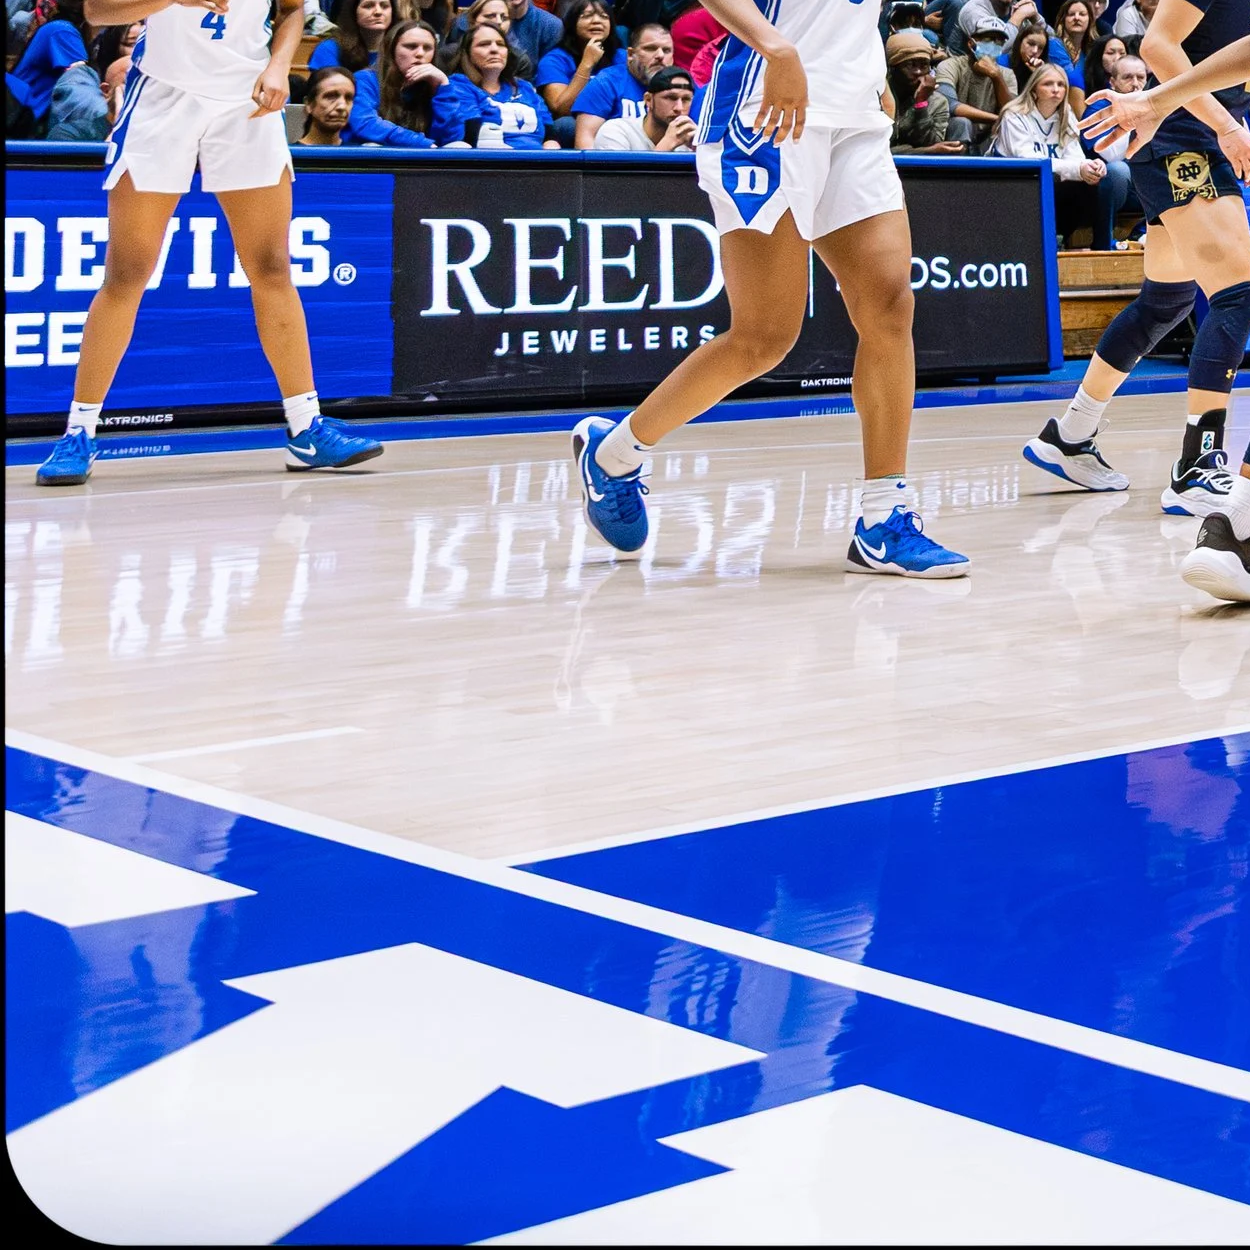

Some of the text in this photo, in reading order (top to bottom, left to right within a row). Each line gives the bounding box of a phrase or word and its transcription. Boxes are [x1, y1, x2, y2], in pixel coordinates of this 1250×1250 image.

[200, 11, 226, 40] 4
[420, 217, 726, 316] REED
[494, 324, 716, 357] JEWELERS
[801, 376, 854, 389] DAKTRONI
[97, 413, 174, 427] AKTRONICS
